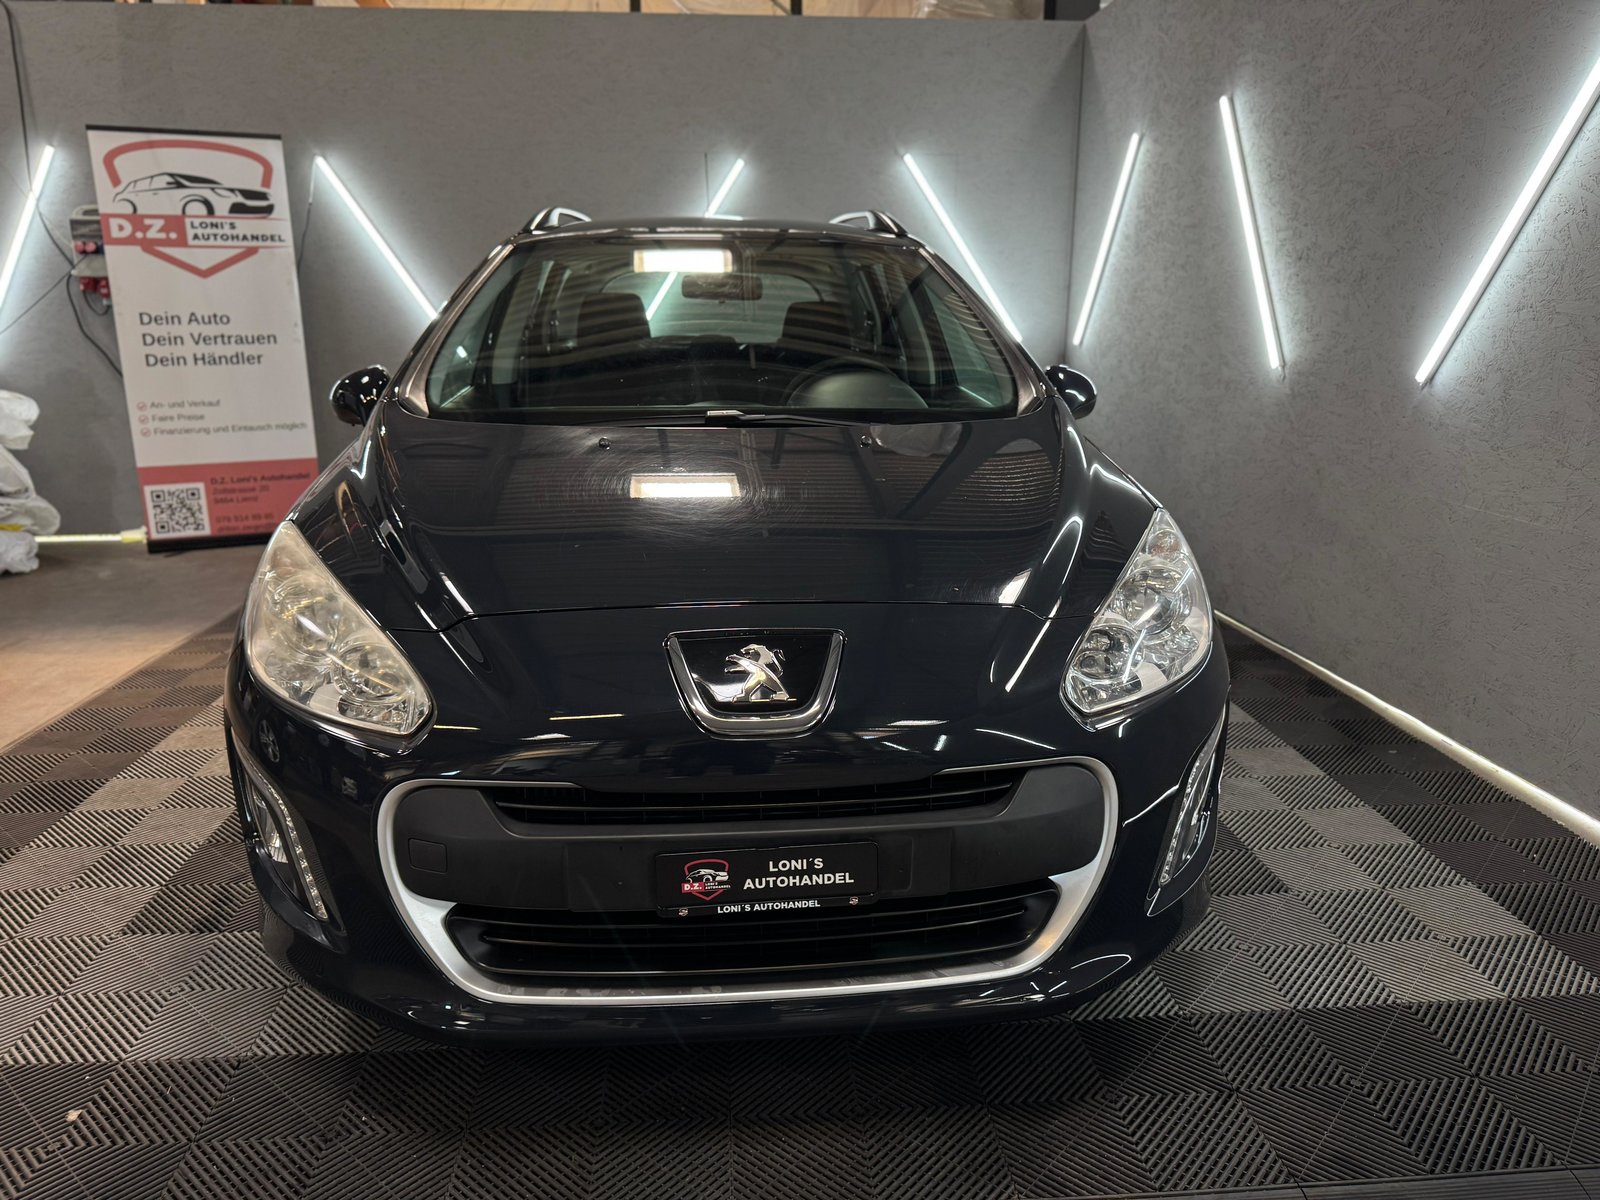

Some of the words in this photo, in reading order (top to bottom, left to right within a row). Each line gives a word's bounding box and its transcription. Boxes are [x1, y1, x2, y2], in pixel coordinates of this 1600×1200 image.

[108, 217, 178, 239] D.Z.
[192, 233, 286, 243] AUTOHANDEL
[139, 311, 182, 326] Dein
[187, 311, 231, 325] Auto
[142, 332, 184, 347] Dein
[190, 332, 278, 346] Vertrauen
[145, 352, 187, 367] Dein
[193, 351, 263, 366] Händler
[149, 401, 165, 409] An-
[167, 400, 185, 408] und
[187, 399, 221, 408] Verkauf
[151, 414, 175, 422] Faire
[177, 413, 205, 422] Preise
[153, 425, 211, 436] Finanzierung
[213, 424, 229, 433] und
[231, 422, 272, 433] Eintausch
[274, 420, 307, 432] möglich
[260, 472, 310, 481] Autohandel
[684, 882, 703, 891] D.Z.
[743, 872, 854, 890] AUTOHANDEL
[753, 900, 821, 911] AUTOHANDEL
